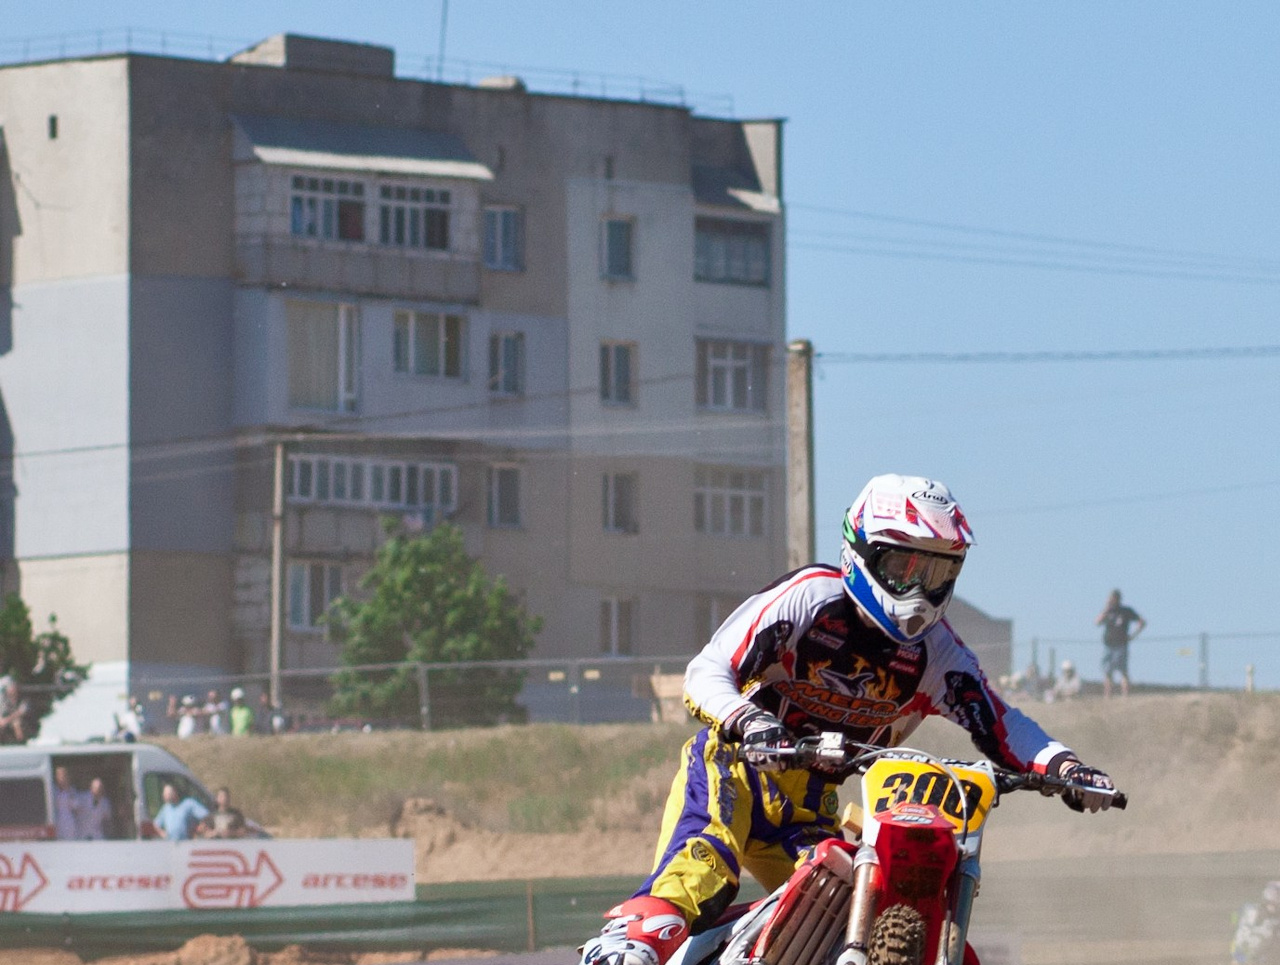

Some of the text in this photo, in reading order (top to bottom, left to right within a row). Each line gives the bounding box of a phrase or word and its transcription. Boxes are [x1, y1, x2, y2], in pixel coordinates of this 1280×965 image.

[775, 681, 846, 721] RACING
[793, 682, 897, 713] MEFO
[875, 772, 983, 821] 300
[67, 874, 172, 890] arcese
[302, 872, 407, 889] arcese
